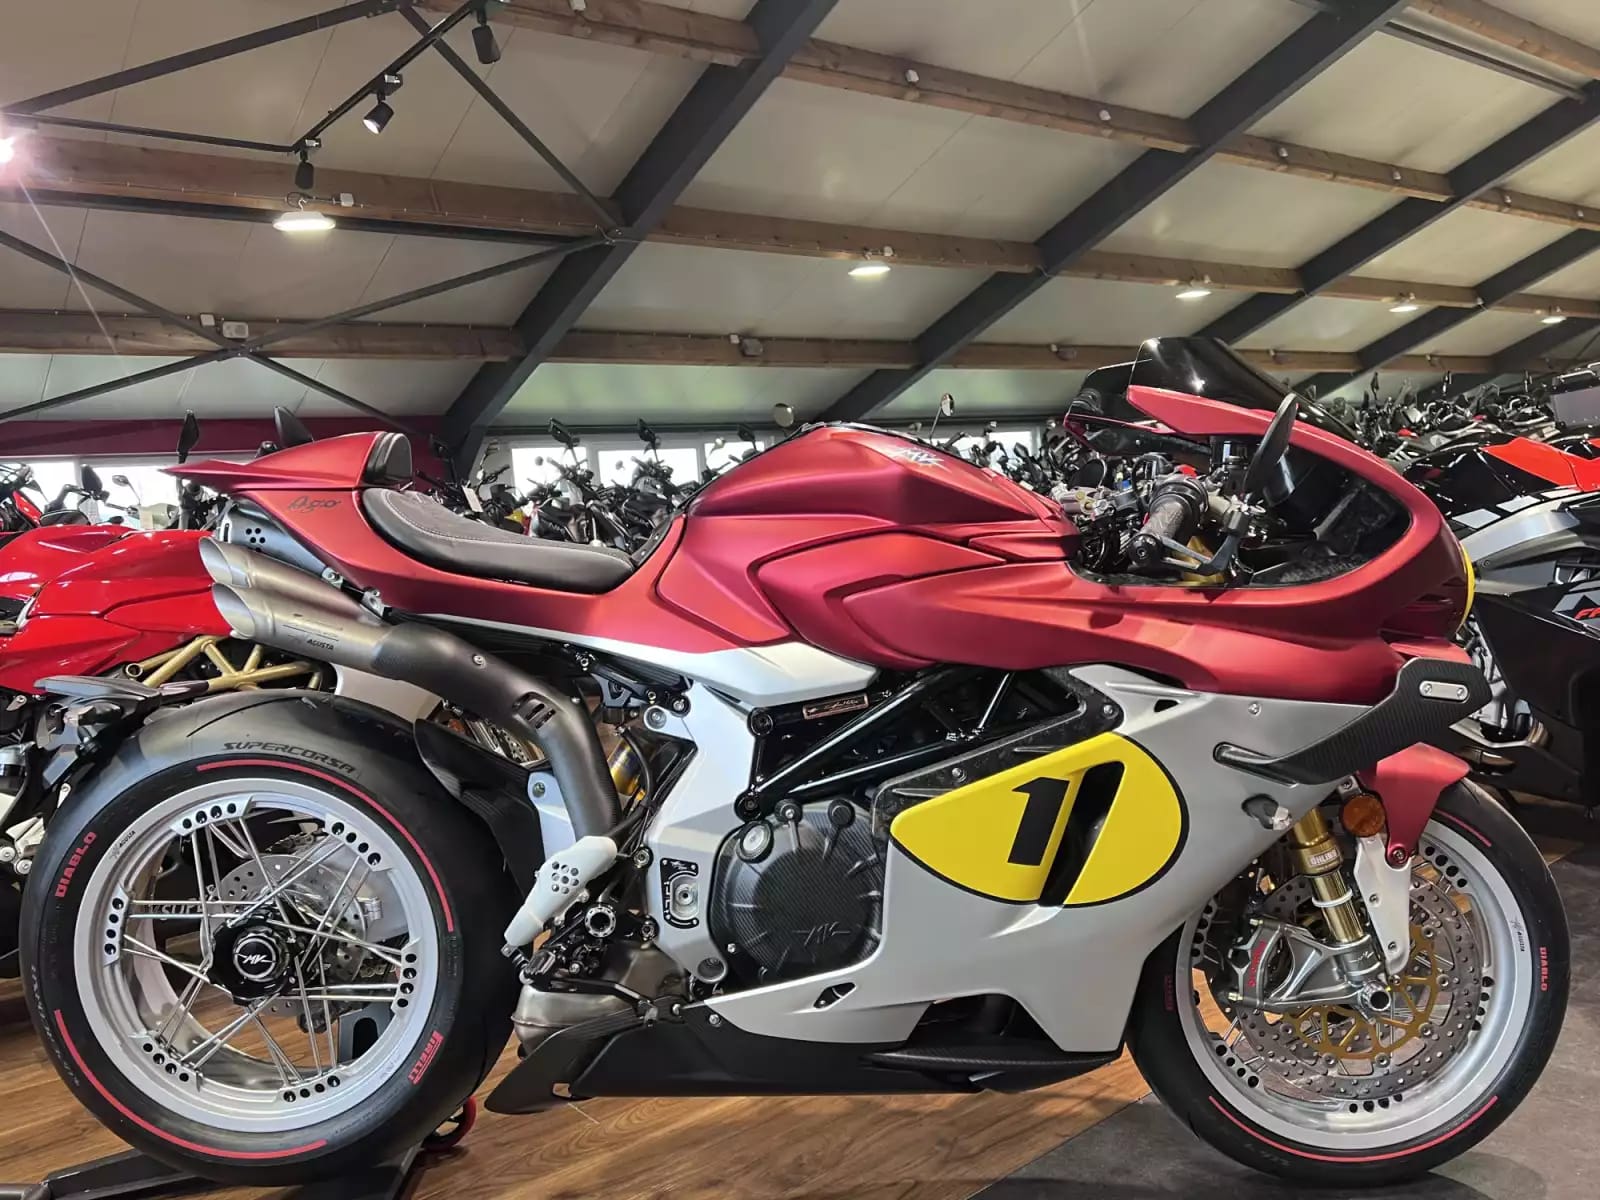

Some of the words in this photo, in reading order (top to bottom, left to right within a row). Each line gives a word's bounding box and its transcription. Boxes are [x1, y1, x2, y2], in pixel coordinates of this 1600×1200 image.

[306, 639, 334, 650] AGUSTA
[223, 741, 356, 774] SUPERCORSA
[1007, 776, 1070, 867] 1
[54, 831, 97, 898] DIABLO
[1540, 946, 1549, 992] DIABLO
[407, 1030, 445, 1085] PIRELLI
